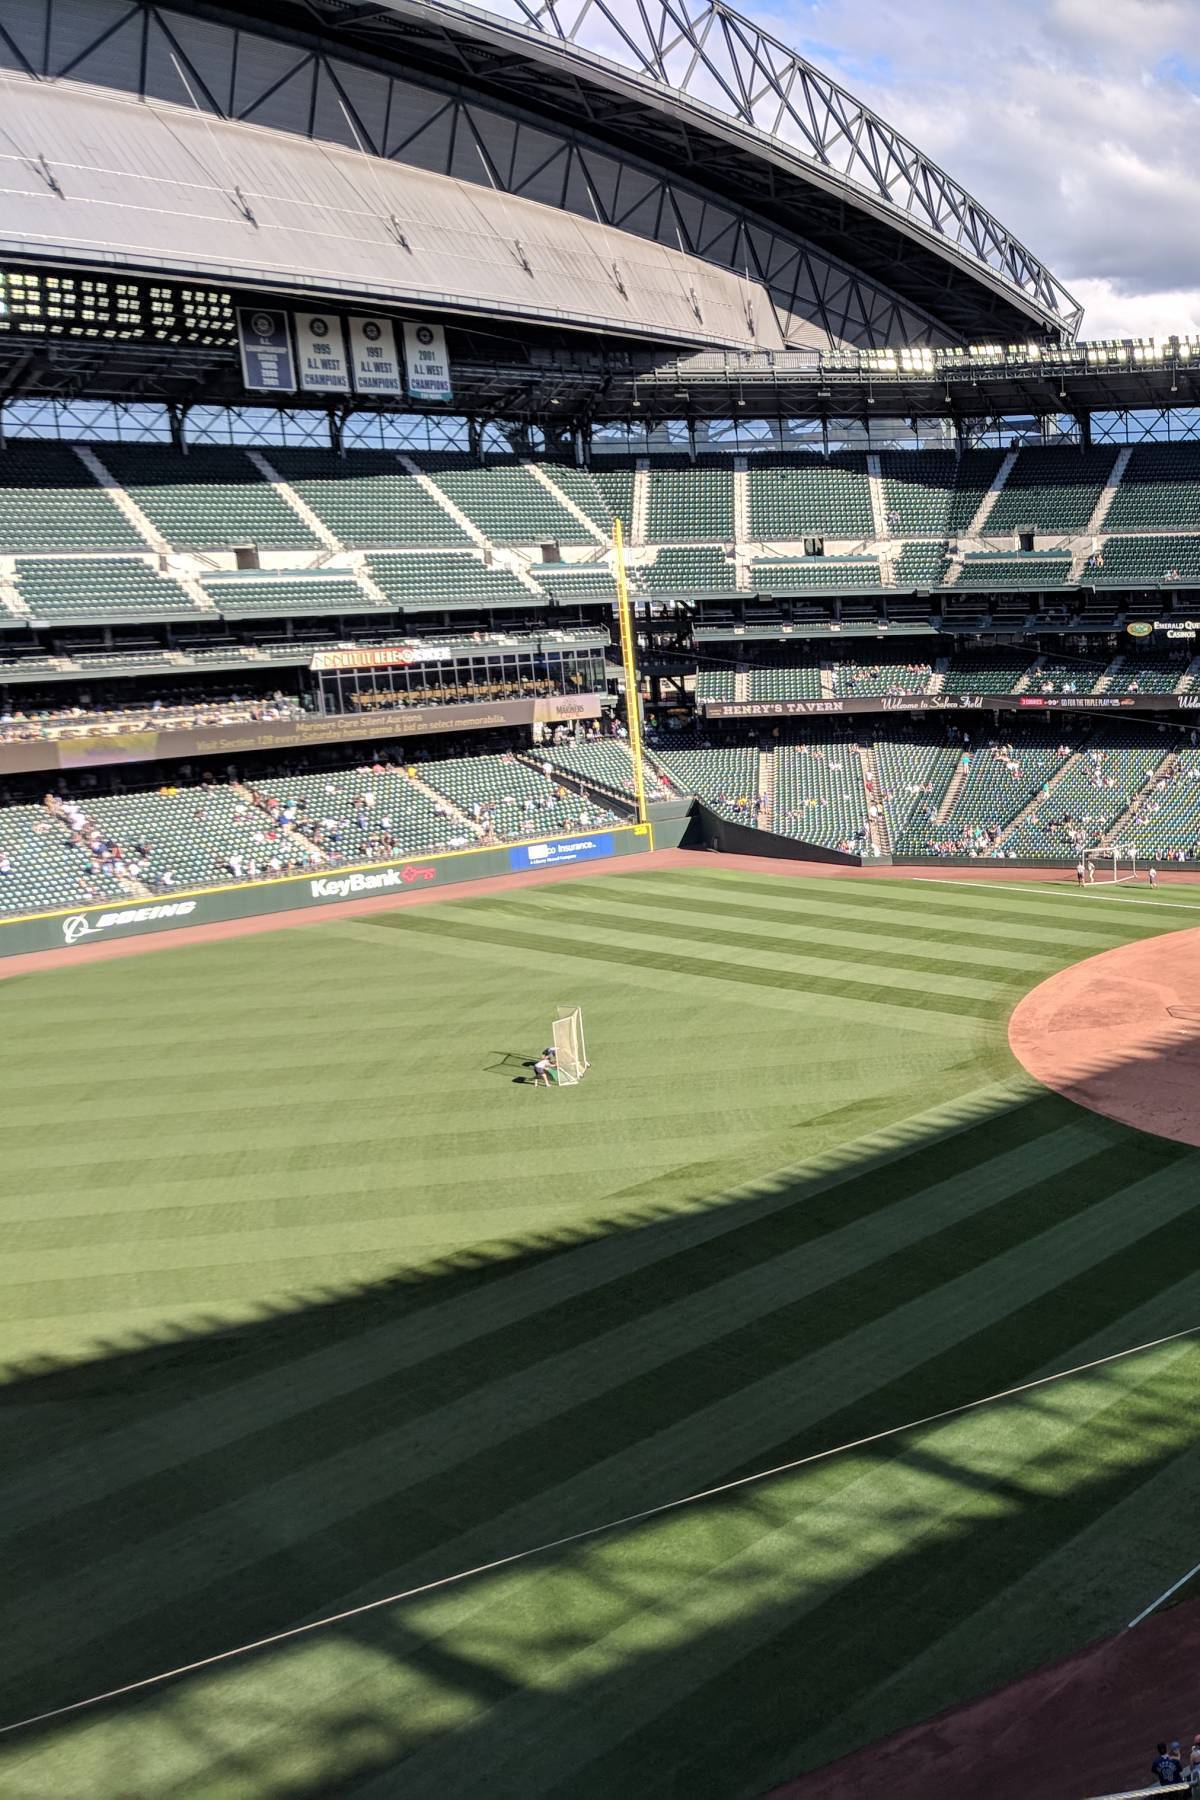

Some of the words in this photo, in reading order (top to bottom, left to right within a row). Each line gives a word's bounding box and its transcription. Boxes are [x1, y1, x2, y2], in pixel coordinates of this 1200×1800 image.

[320, 359, 341, 371] WEST
[373, 362, 393, 374] WEST
[426, 365, 444, 377] WEST
[304, 373, 348, 387] CHAMPIONS
[357, 376, 399, 390] CHAMPIONS
[410, 379, 450, 392] CHAMPIONS
[1154, 621, 1184, 630] EMERALD
[1167, 630, 1196, 639] CASINOS
[723, 703, 783, 716] HENRY'S
[786, 701, 844, 713] TAVERN
[882, 697, 919, 710] Welcome
[929, 696, 958, 709] Safeco
[959, 696, 984, 709] Field
[1085, 698, 1098, 707] TRIPLE
[295, 721, 336, 732] Mariners
[337, 719, 360, 729] Care
[360, 717, 385, 728] Silent
[403, 723, 416, 732] bid
[430, 719, 454, 730] select
[311, 868, 402, 897] KeyBank
[96, 901, 197, 927] BOEING
